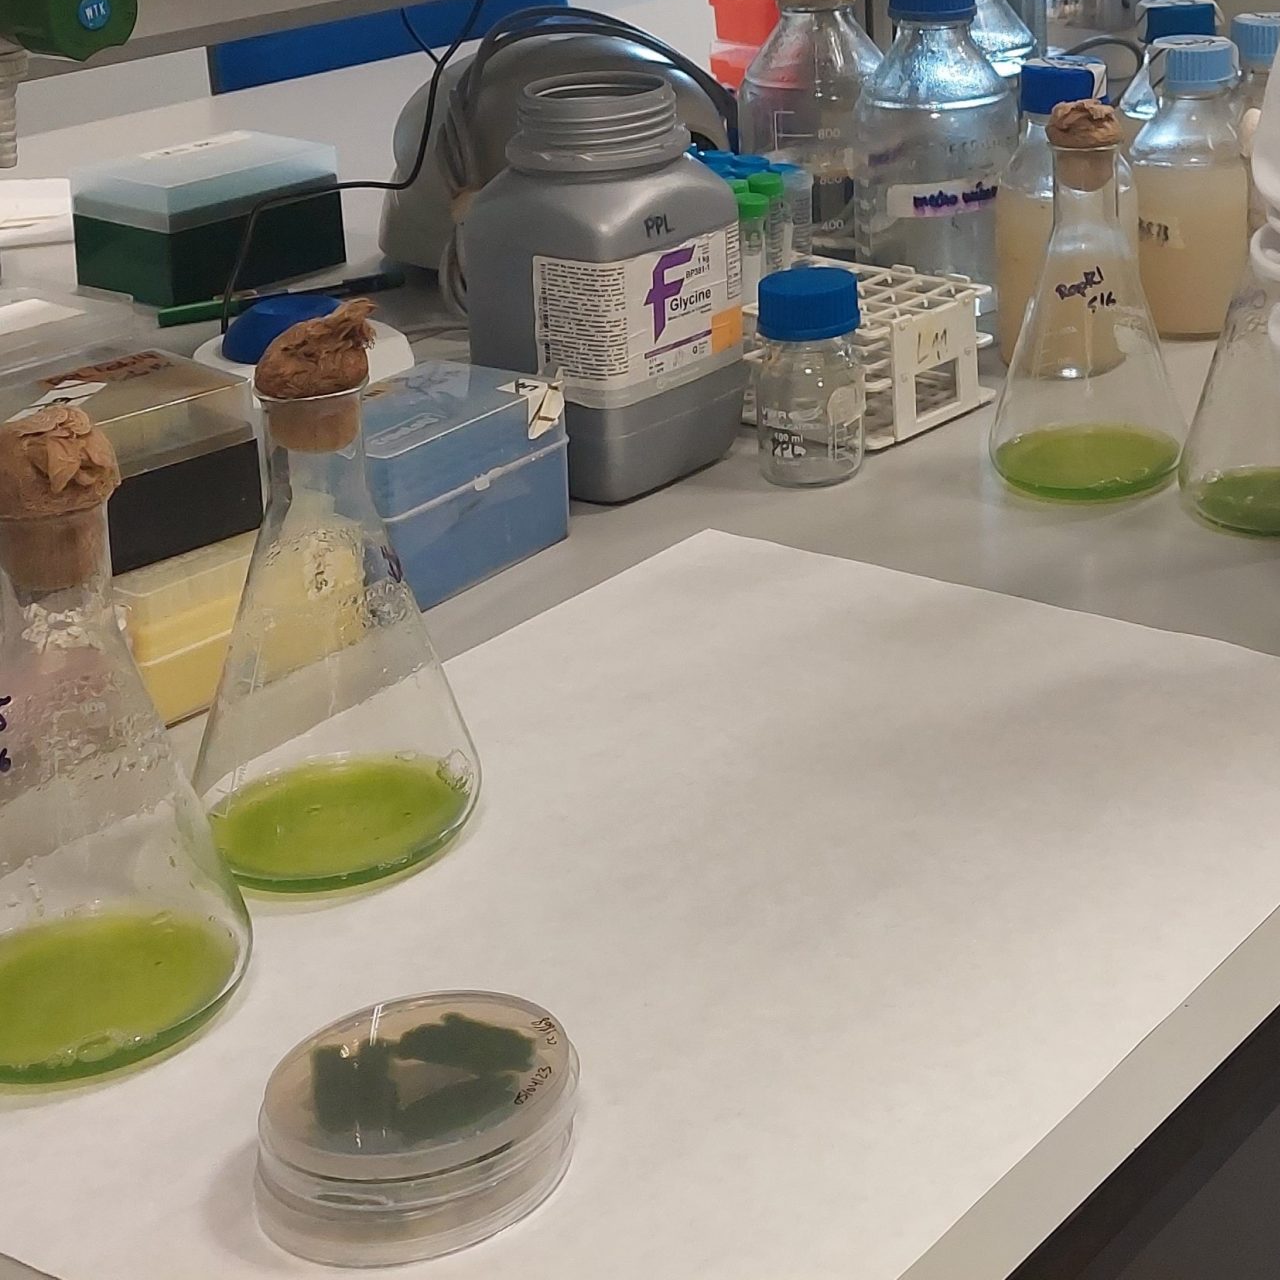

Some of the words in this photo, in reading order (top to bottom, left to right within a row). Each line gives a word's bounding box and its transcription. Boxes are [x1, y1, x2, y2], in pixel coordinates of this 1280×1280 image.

[644, 214, 675, 239] PPL
[821, 220, 844, 231] 400
[670, 288, 712, 312] Glycine
